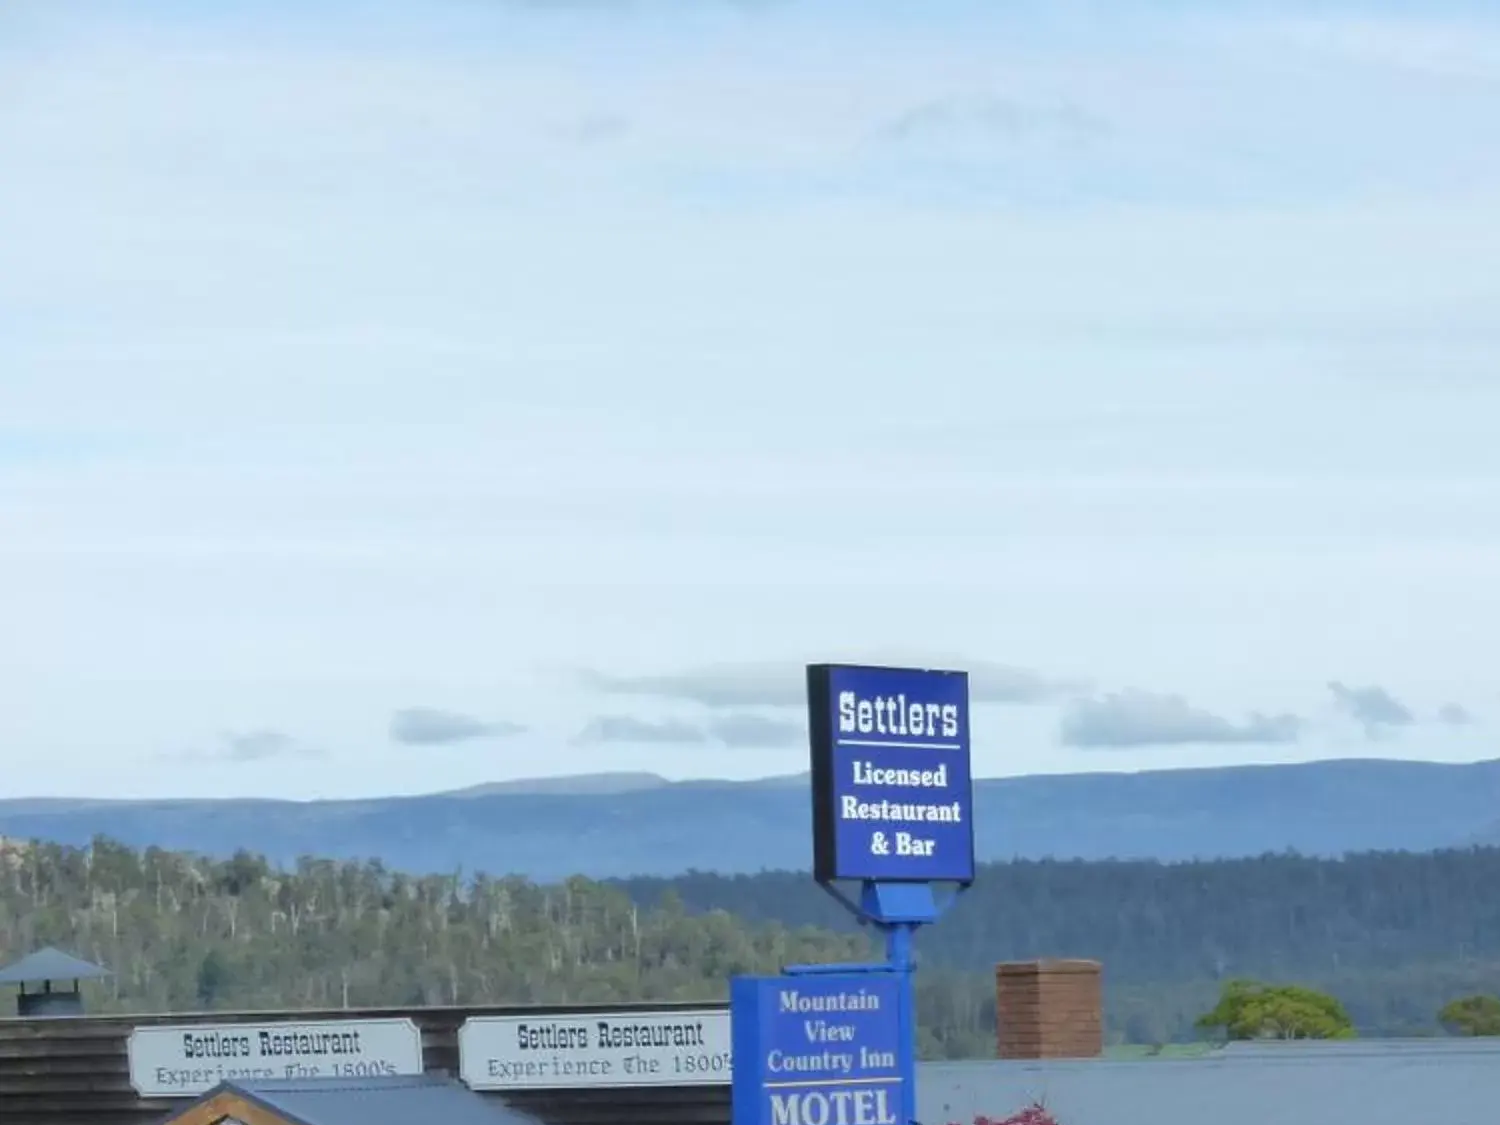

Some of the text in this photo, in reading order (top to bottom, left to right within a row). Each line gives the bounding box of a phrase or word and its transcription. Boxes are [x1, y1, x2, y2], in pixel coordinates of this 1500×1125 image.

[838, 691, 958, 737] Settlers
[852, 761, 948, 788] Licensed
[841, 795, 961, 823] Restaurant
[871, 830, 936, 857] & Bar
[779, 987, 880, 1013] Mountain
[183, 1029, 361, 1058] Settlers Restaurant
[518, 1021, 705, 1050] Settlers Restaurant
[803, 1019, 856, 1043] View
[487, 1056, 612, 1079] Experience
[623, 1054, 660, 1075] The
[767, 1046, 895, 1073] Country Inn
